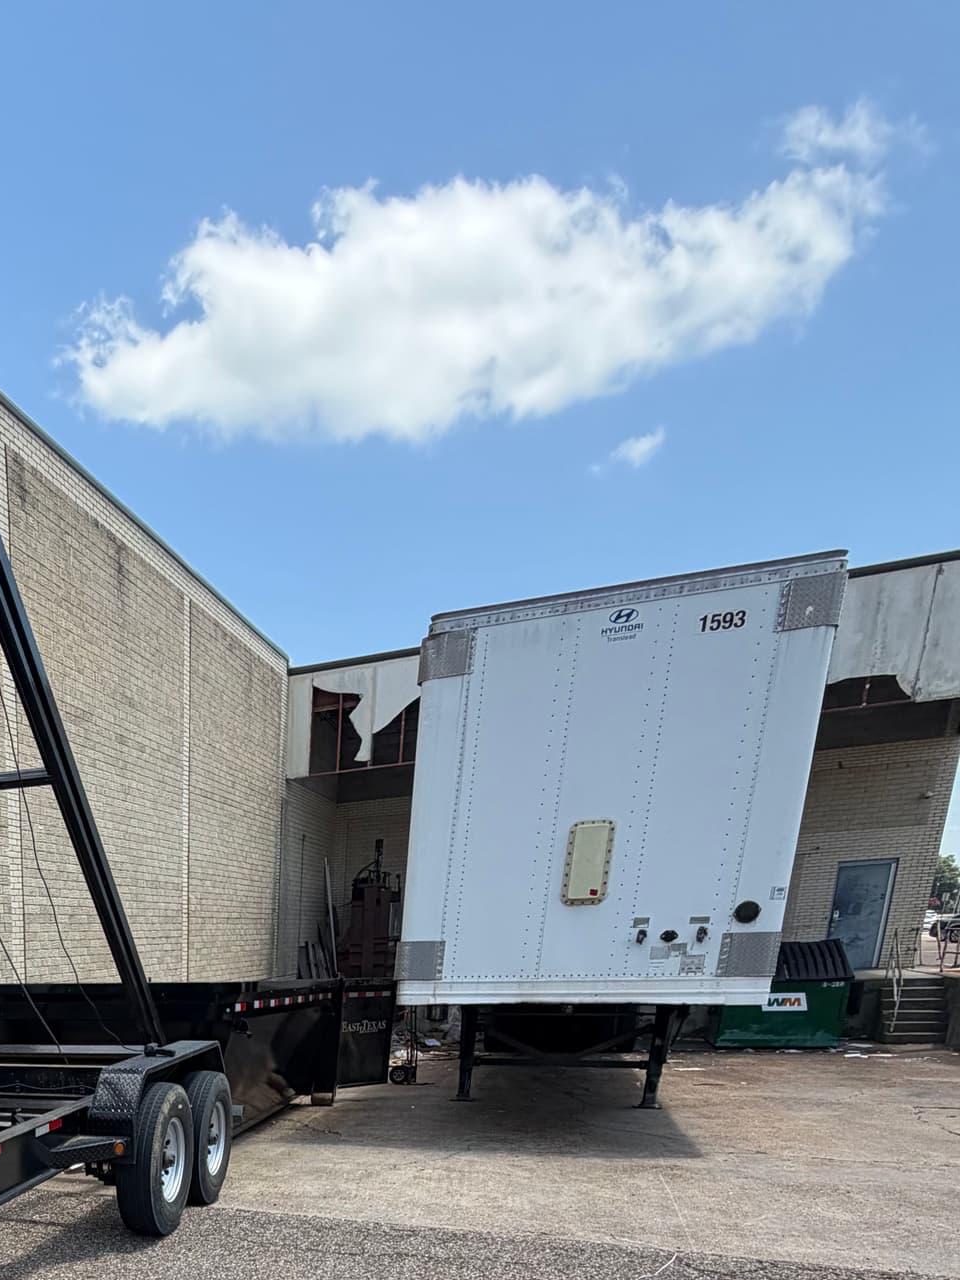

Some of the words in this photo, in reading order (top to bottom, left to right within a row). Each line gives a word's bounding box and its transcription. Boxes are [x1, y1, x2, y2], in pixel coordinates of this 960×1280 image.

[698, 610, 746, 633] 1593
[601, 623, 643, 635] HYUNDAI
[767, 997, 801, 1007] WM
